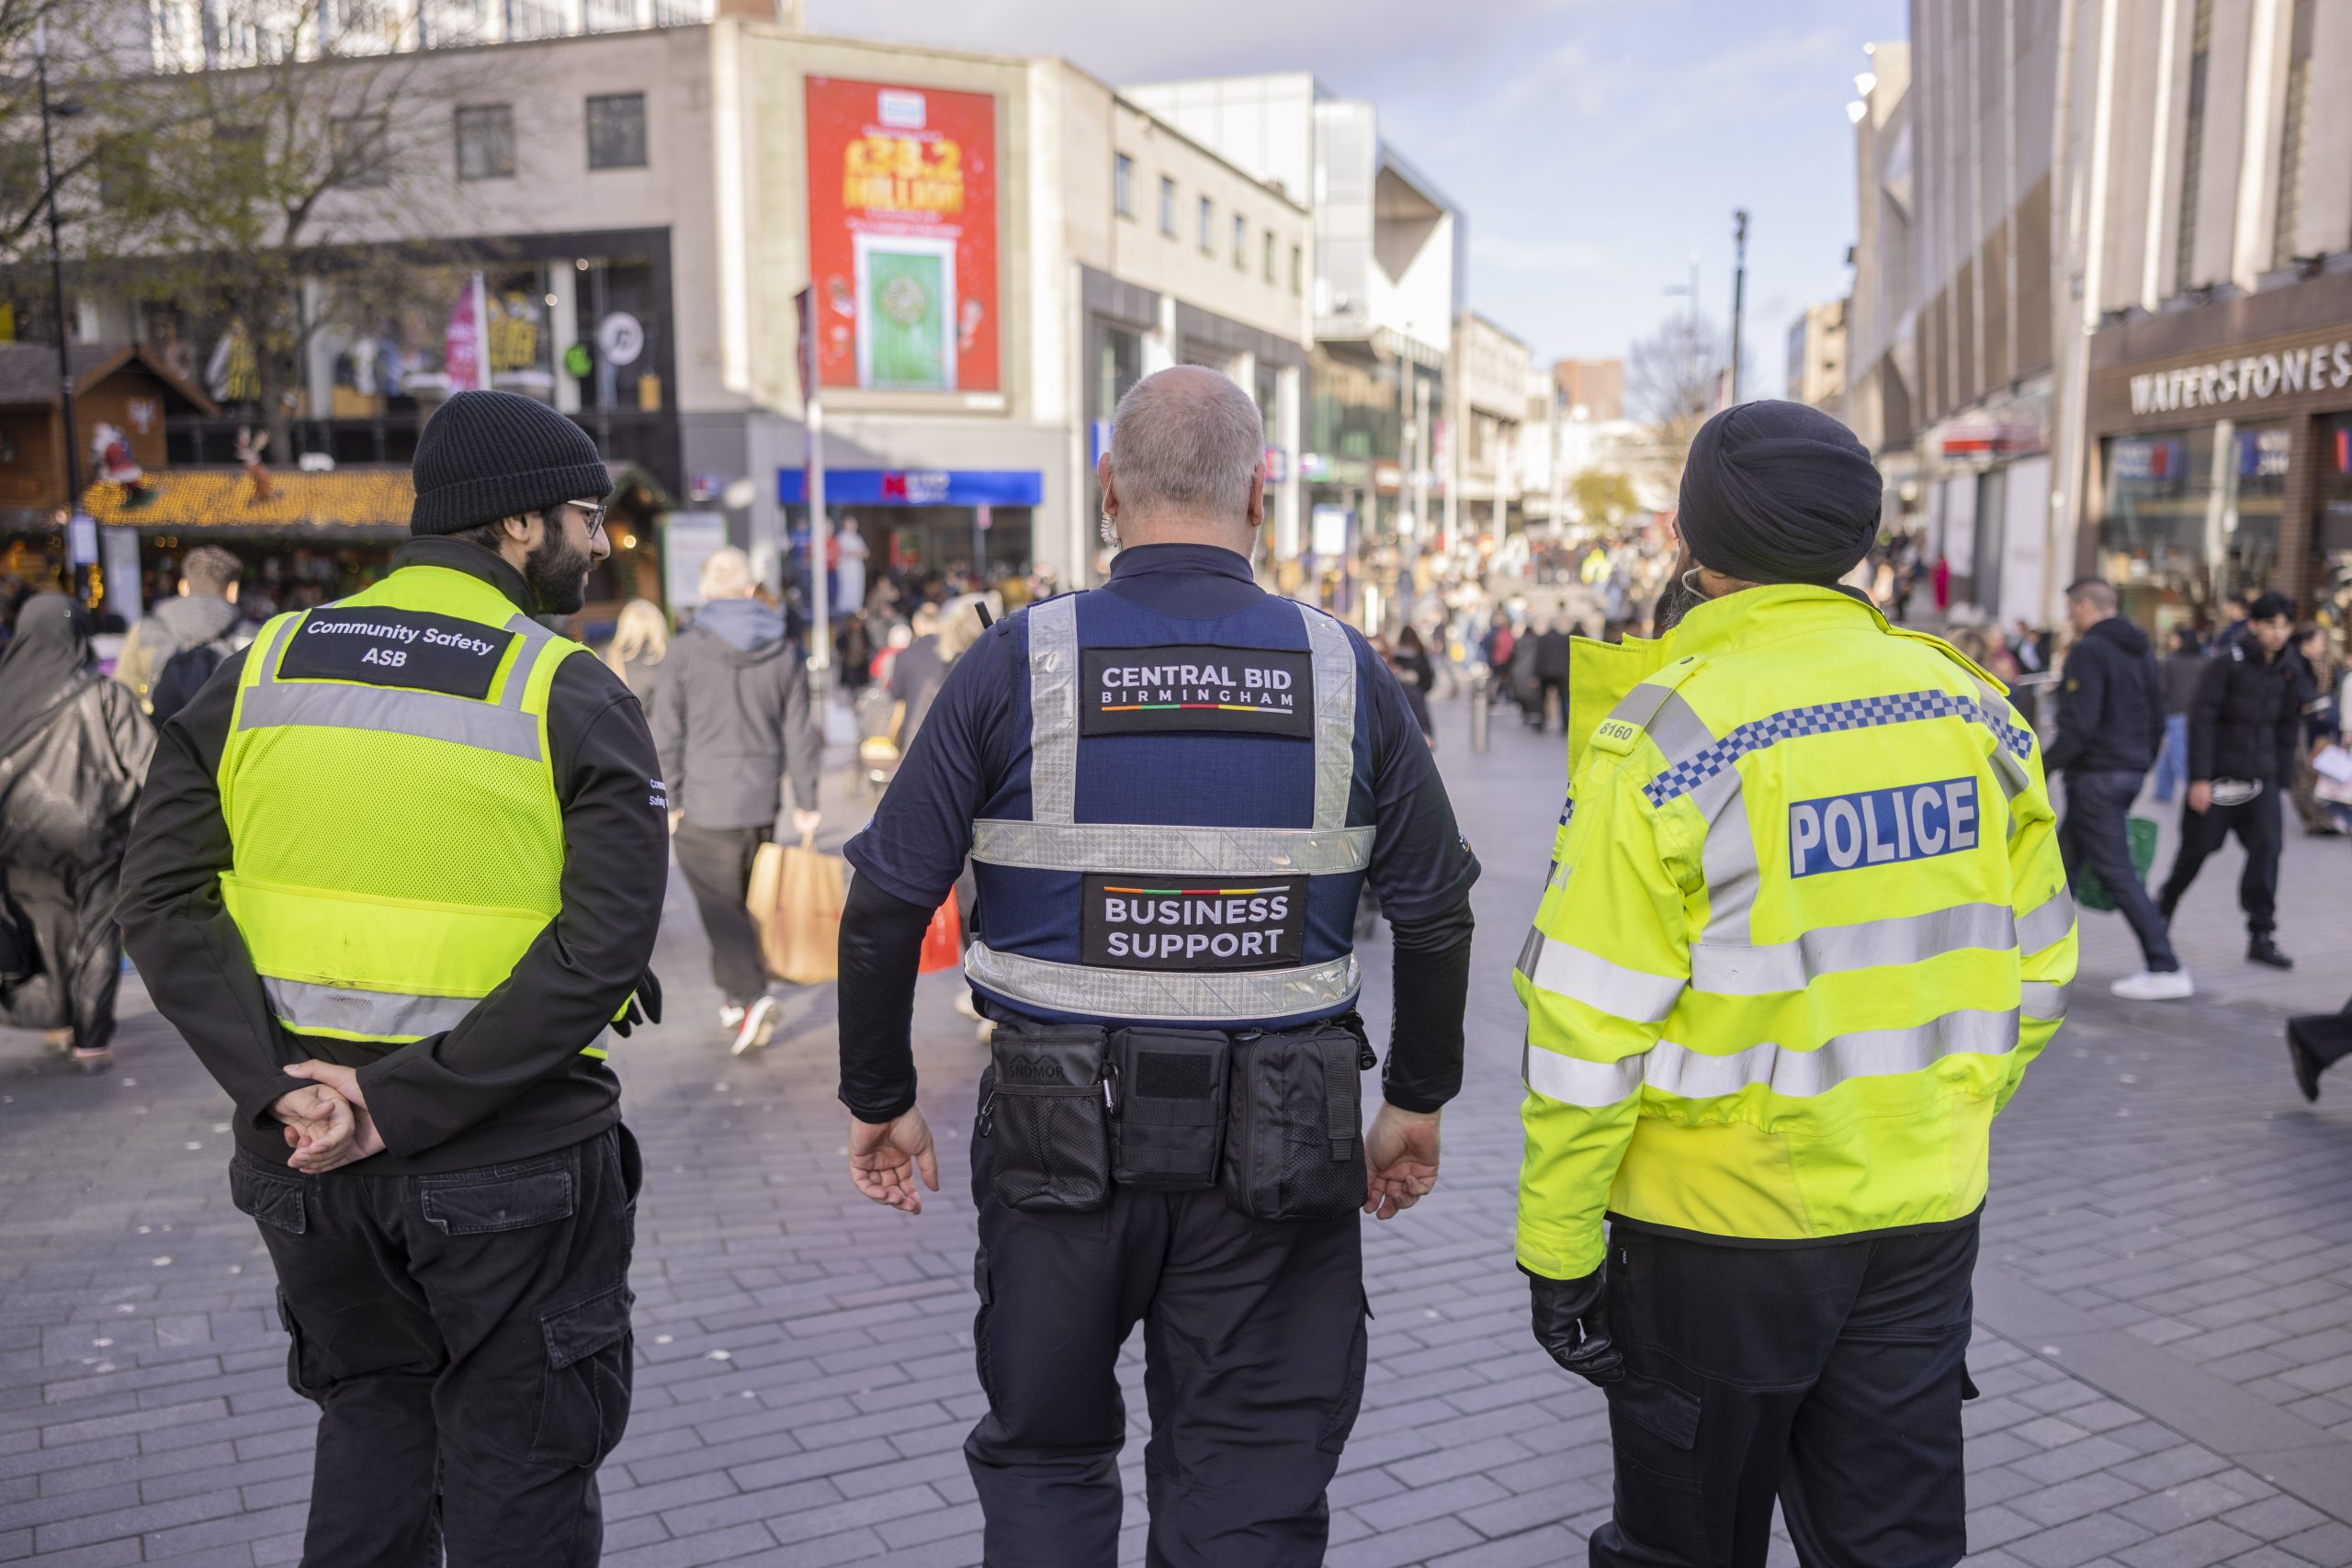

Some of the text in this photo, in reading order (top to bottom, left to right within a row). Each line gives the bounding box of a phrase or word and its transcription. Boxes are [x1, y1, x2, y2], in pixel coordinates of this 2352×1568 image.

[2130, 341, 2352, 414] WATERSTONES
[307, 621, 494, 656] Community Safety
[361, 648, 407, 667] ASB
[1102, 665, 1292, 690] CENTRAL BID
[1102, 689, 1294, 706] BIRMINGHAM
[1599, 722, 1633, 740] 8160
[1791, 781, 1975, 875] POLICE
[1105, 896, 1288, 925] BUSINESS
[1107, 929, 1284, 958] SUPPORT
[1009, 1066, 1064, 1078] SNDMOR
